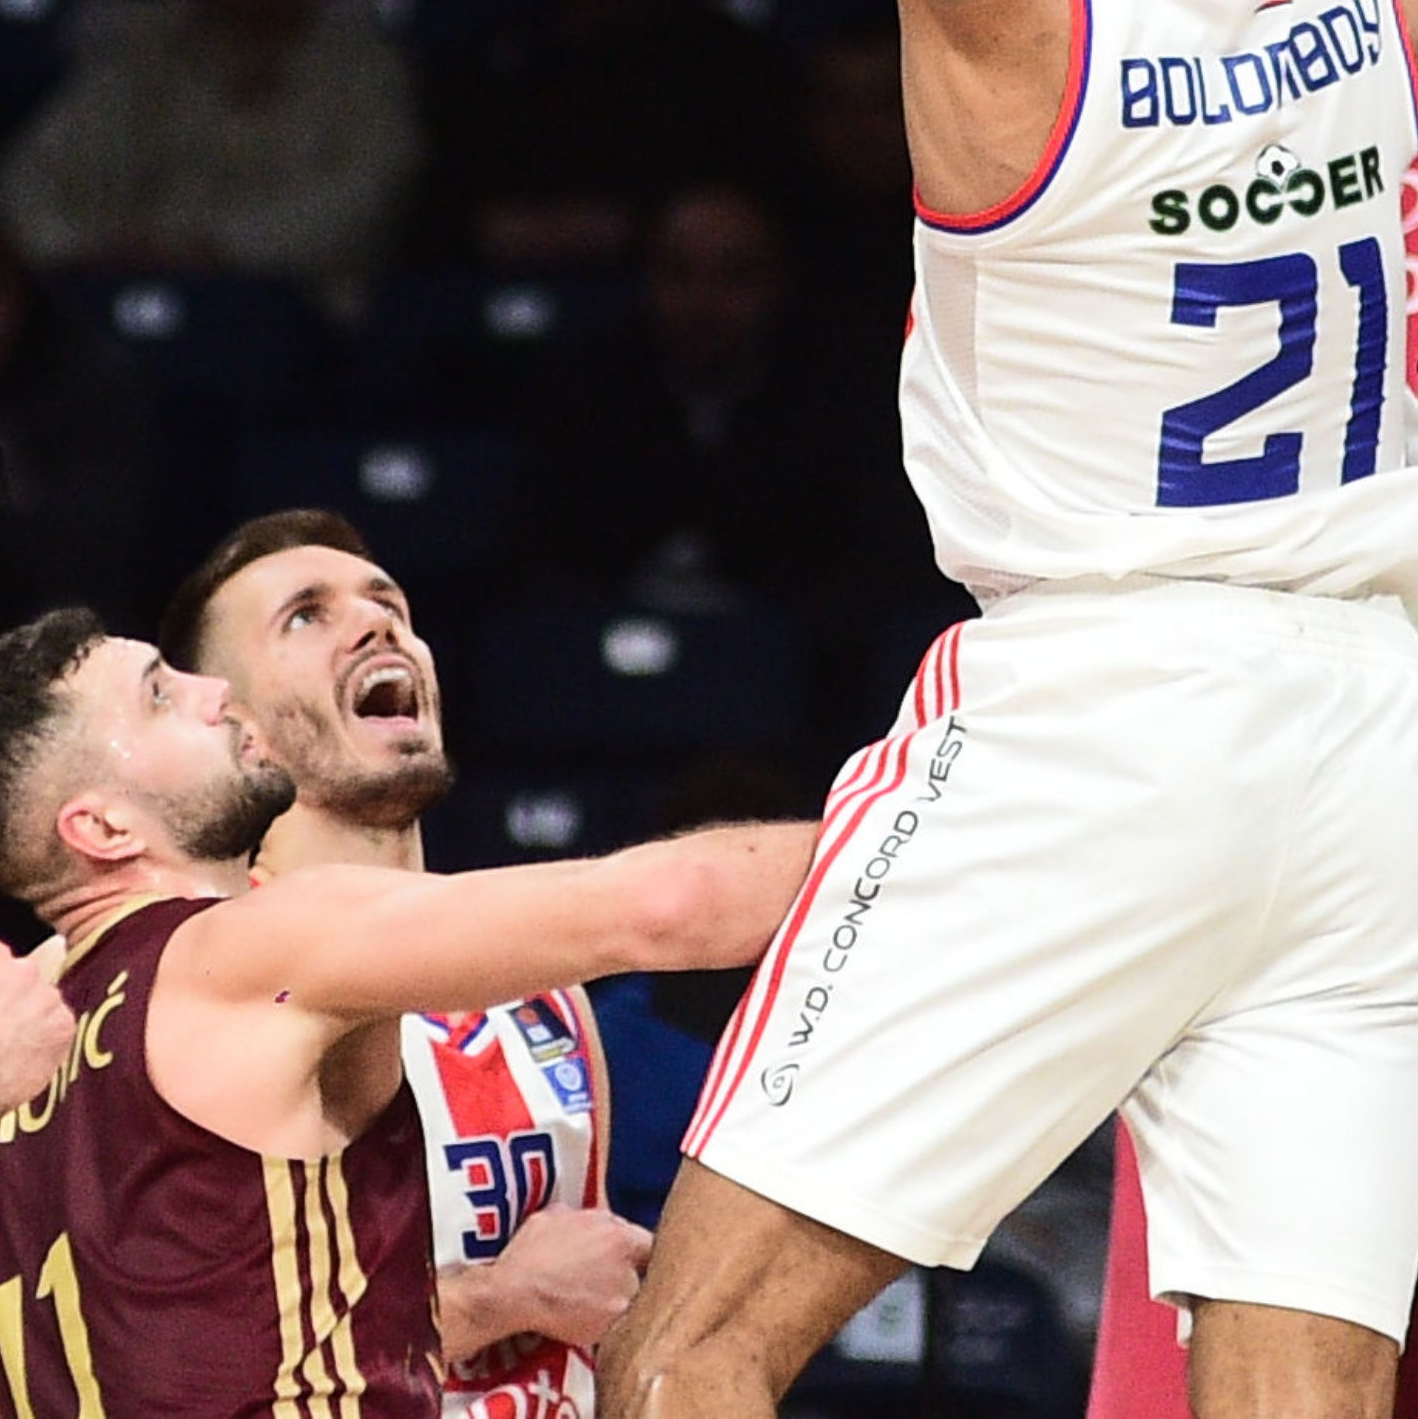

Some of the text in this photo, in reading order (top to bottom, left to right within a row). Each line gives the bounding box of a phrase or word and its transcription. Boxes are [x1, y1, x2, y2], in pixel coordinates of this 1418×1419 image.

[1148, 145, 1385, 236] SOCCER
[1155, 236, 1388, 508] 21
[788, 716, 968, 1048] W.D. CONCORD VEST
[443, 1132, 557, 1261] 30
